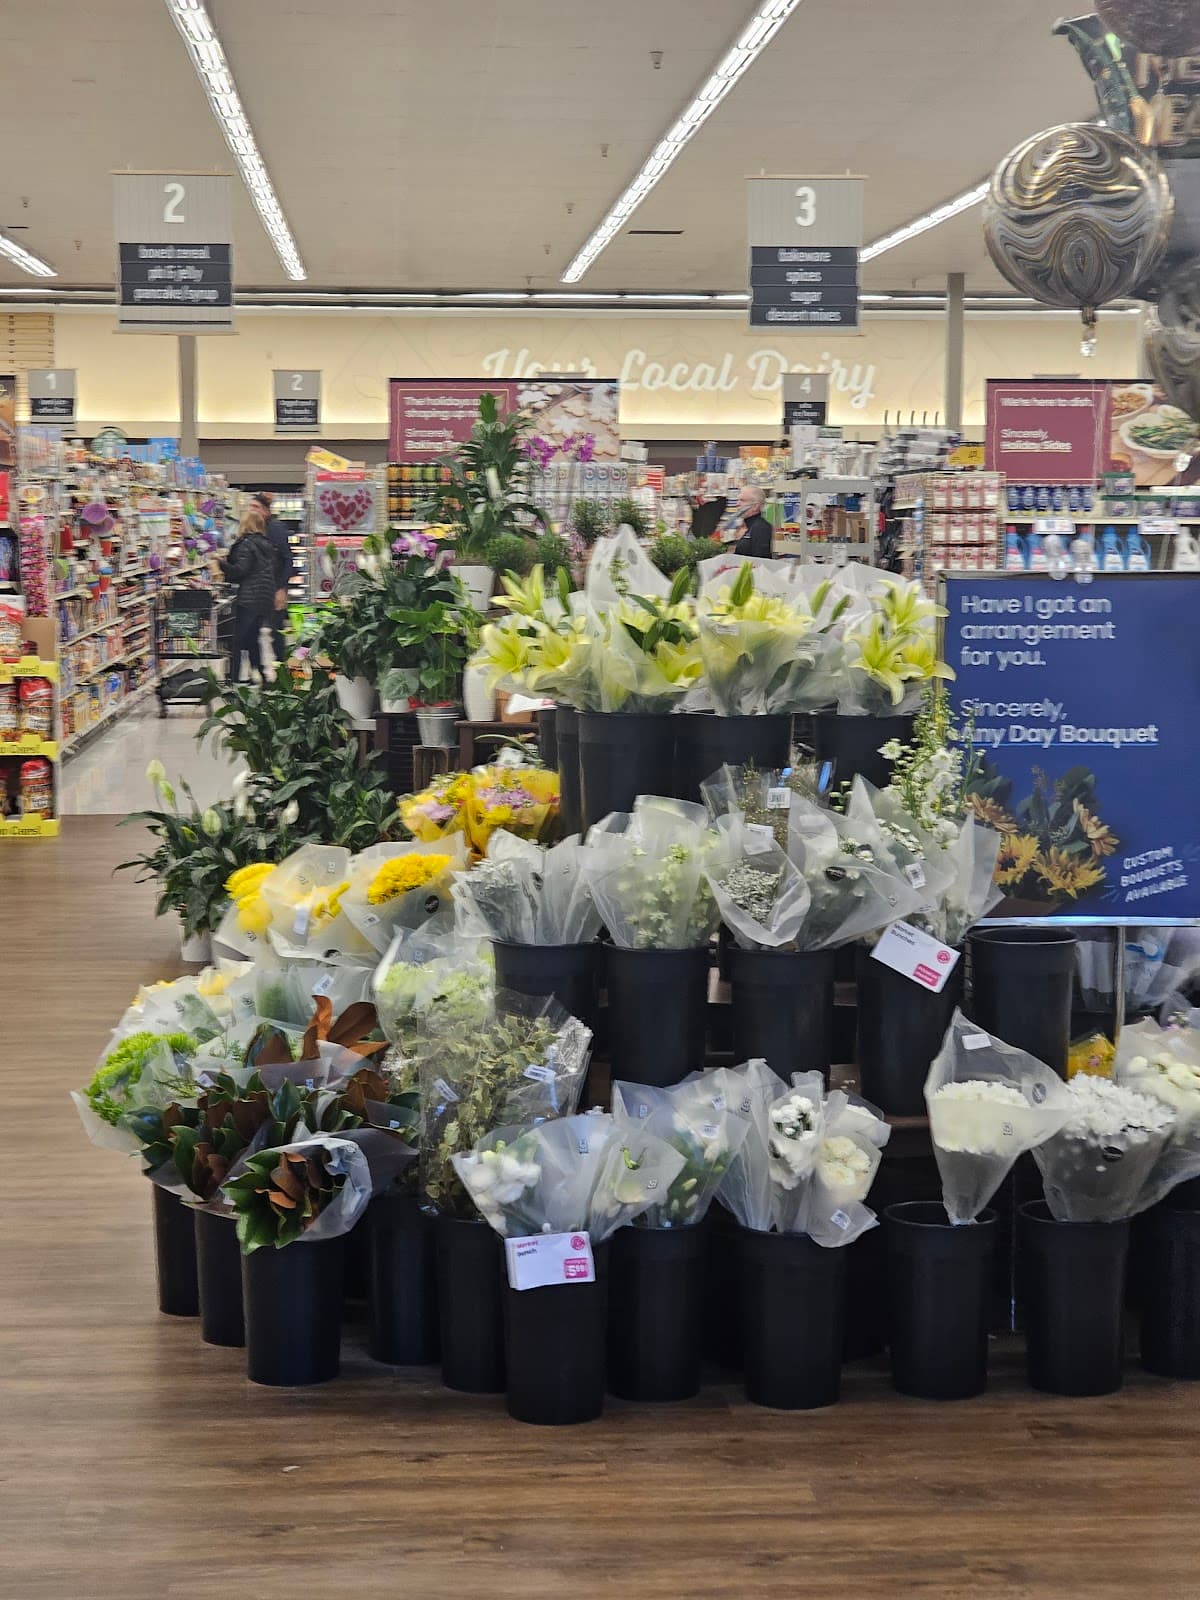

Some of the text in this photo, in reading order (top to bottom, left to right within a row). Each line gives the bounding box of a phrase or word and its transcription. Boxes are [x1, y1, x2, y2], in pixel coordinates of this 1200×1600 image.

[163, 182, 186, 223] 2
[794, 186, 816, 227] 3
[45, 373, 57, 390] 1
[620, 349, 739, 391] Local
[291, 374, 303, 391] 2
[800, 377, 812, 394] 4
[404, 428, 453, 439] Sincerely,
[1001, 429, 1048, 440] Sincerely,
[960, 595, 1112, 619] Have I got an
[960, 621, 1116, 645] arrangement
[960, 646, 1047, 671] for you.
[960, 698, 1068, 722] Sincerely,
[960, 724, 1159, 748] Any Day Bouquet
[1123, 846, 1174, 870] CUSTOM
[1120, 859, 1185, 887] BOUQUETS
[1124, 874, 1190, 902] AVAILABLE
